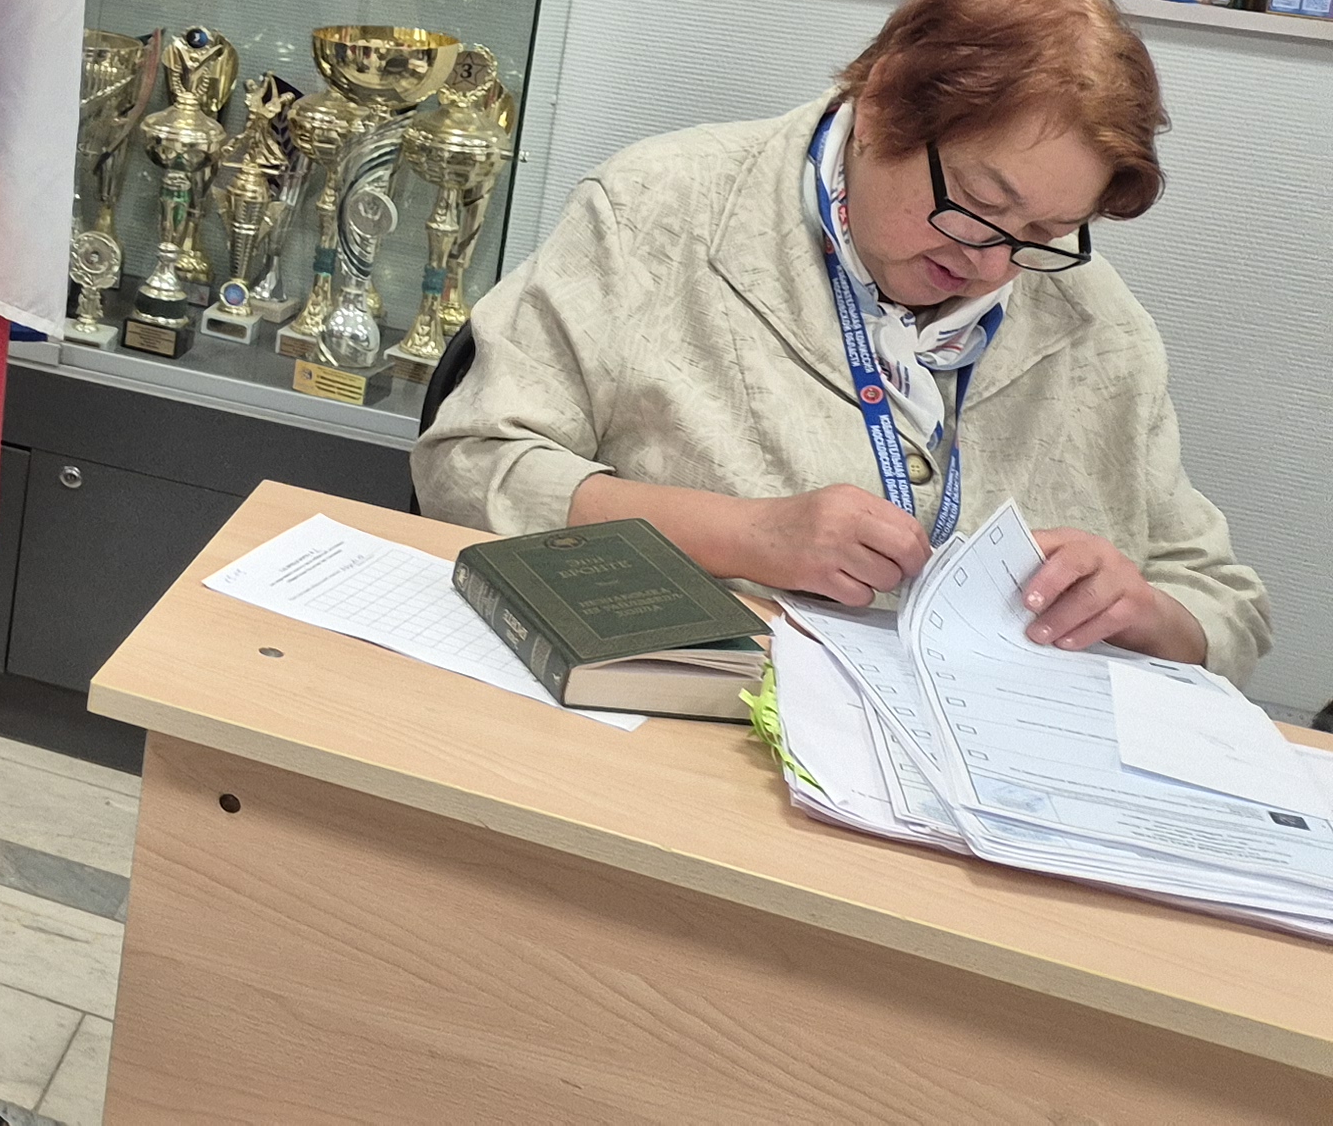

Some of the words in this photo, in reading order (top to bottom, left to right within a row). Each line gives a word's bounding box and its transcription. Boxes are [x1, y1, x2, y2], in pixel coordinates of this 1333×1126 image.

[460, 64, 473, 79] 3
[833, 278, 853, 332] МОСКОВСКОЙ
[844, 331, 860, 367] ОБЛАСТИ
[855, 330, 874, 374] КОМИССИЯ
[870, 424, 894, 478] МОСКОВСКОЙ
[879, 414, 905, 478] ИЗБИРАТЕЛЬНАЯ
[897, 478, 914, 516] КОМИСС
